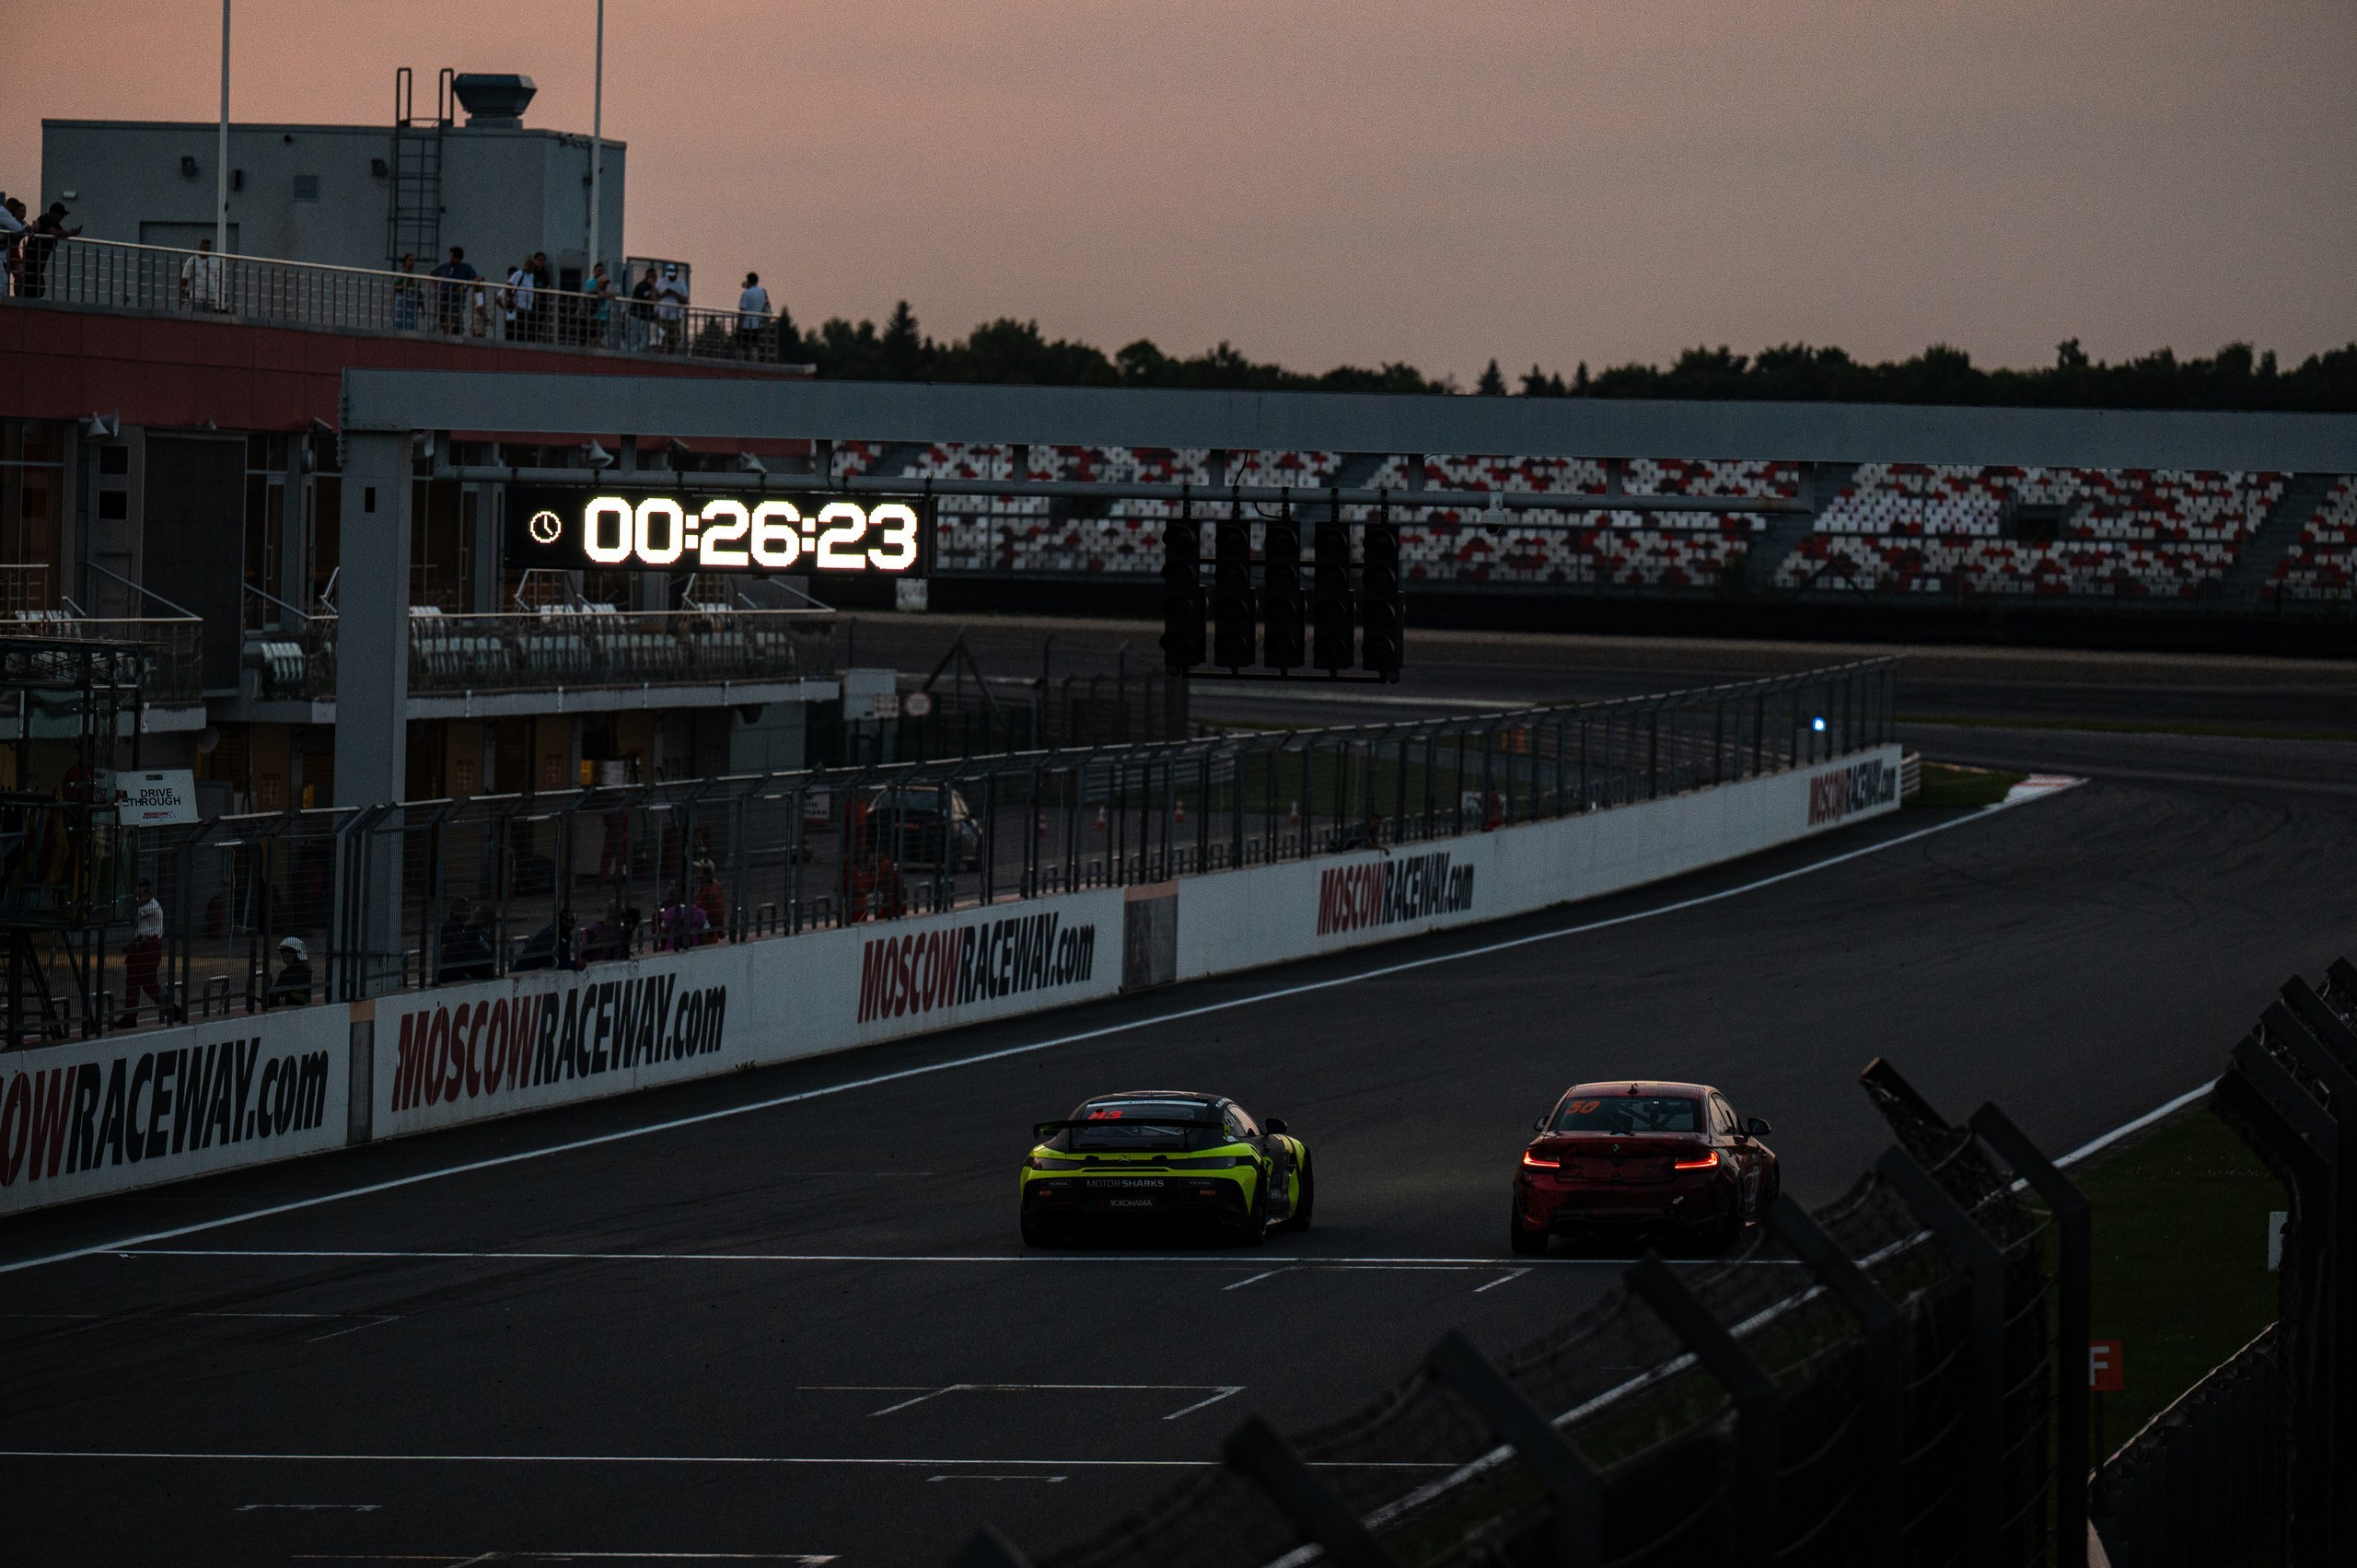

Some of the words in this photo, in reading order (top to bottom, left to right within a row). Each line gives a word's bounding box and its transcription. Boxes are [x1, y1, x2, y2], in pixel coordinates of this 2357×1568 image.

[584, 496, 918, 571] 00:26:23
[129, 796, 181, 807] THROUGH
[140, 788, 173, 798] DRIVE
[1317, 853, 1474, 935] MOSCOWRACEWAY.com
[857, 912, 1095, 1023] MOSCOWRACEWAY.com
[391, 973, 726, 1112] MOSCOWRACEWAY.com
[0, 1038, 329, 1187] OWRACEWAY.com
[1109, 1199, 1153, 1207] YOKOHAMA
